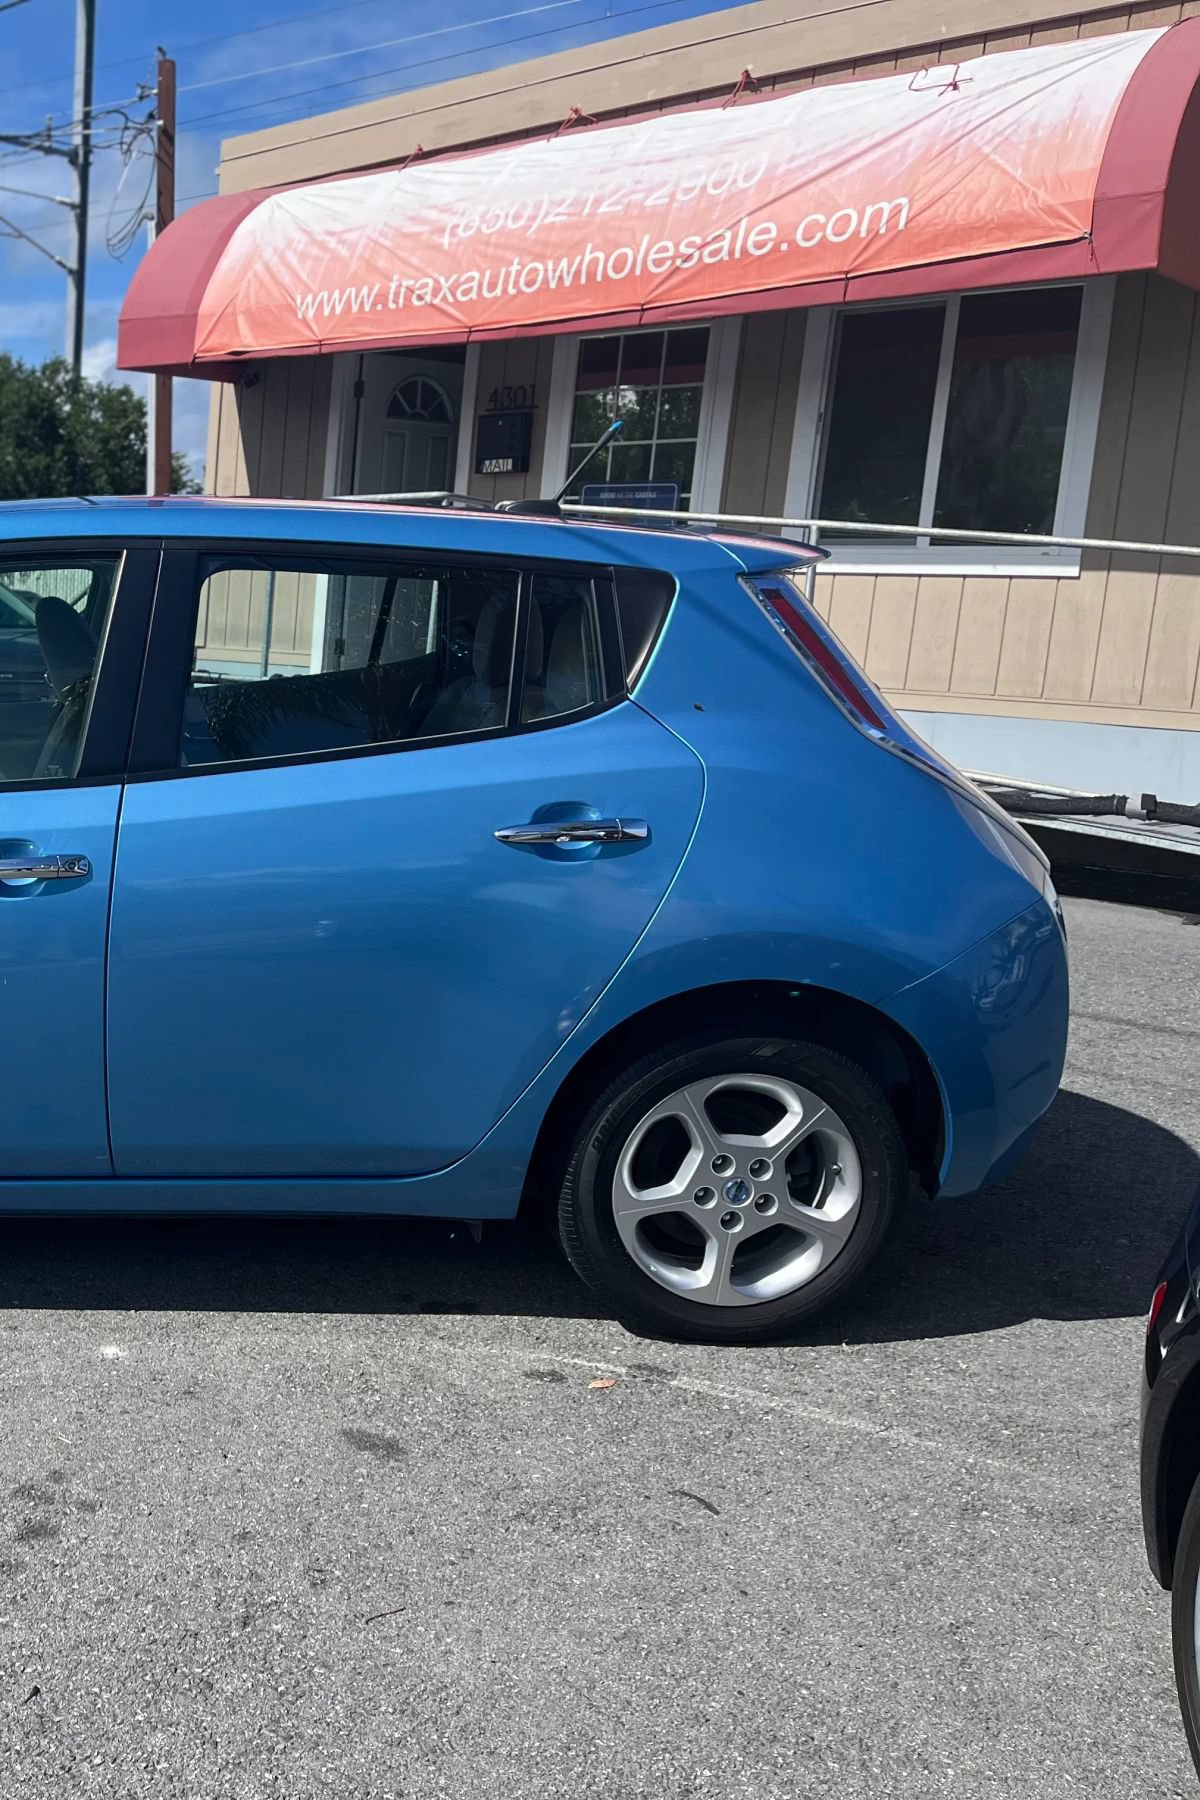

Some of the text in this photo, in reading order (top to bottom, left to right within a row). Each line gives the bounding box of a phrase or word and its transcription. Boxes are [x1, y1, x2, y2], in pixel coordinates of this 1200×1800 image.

[295, 196, 910, 320] www.traxautowholesale.com
[487, 384, 538, 410] 4301
[482, 457, 513, 473] MAIL
